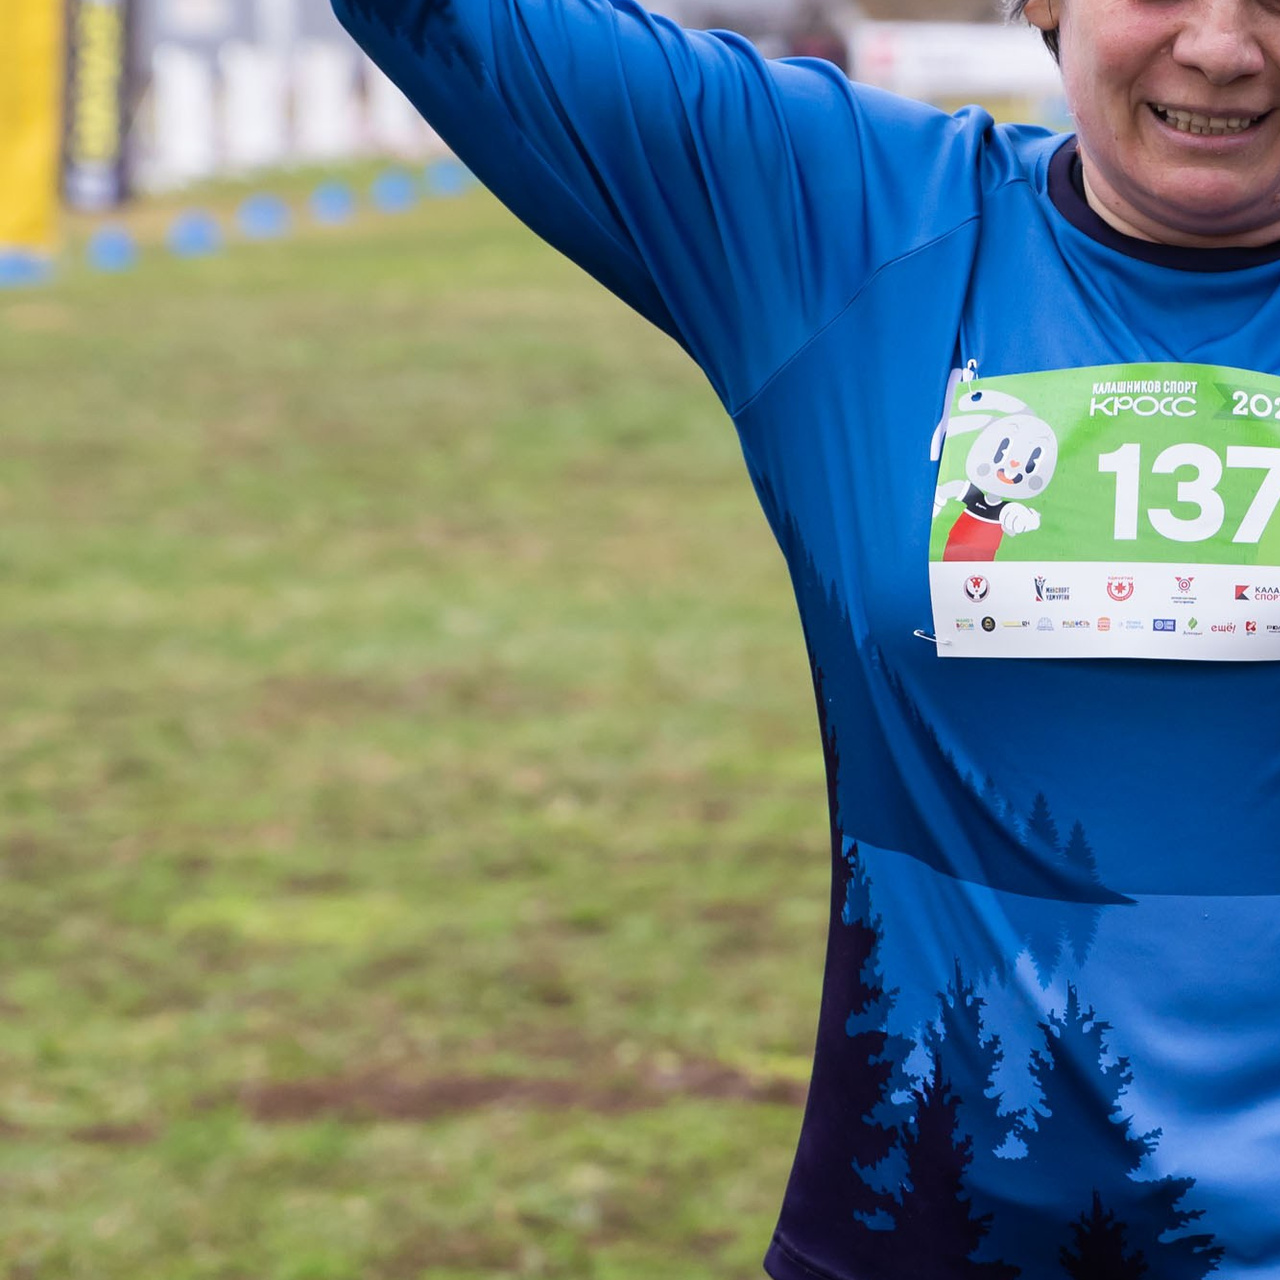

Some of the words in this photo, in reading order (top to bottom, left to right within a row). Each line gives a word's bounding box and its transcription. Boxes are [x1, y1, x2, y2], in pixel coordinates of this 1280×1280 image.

[1092, 380, 1161, 395] КАЛАШНИКОВ
[1163, 380, 1198, 395] СПОРТ
[1089, 395, 1197, 417] КРОСС
